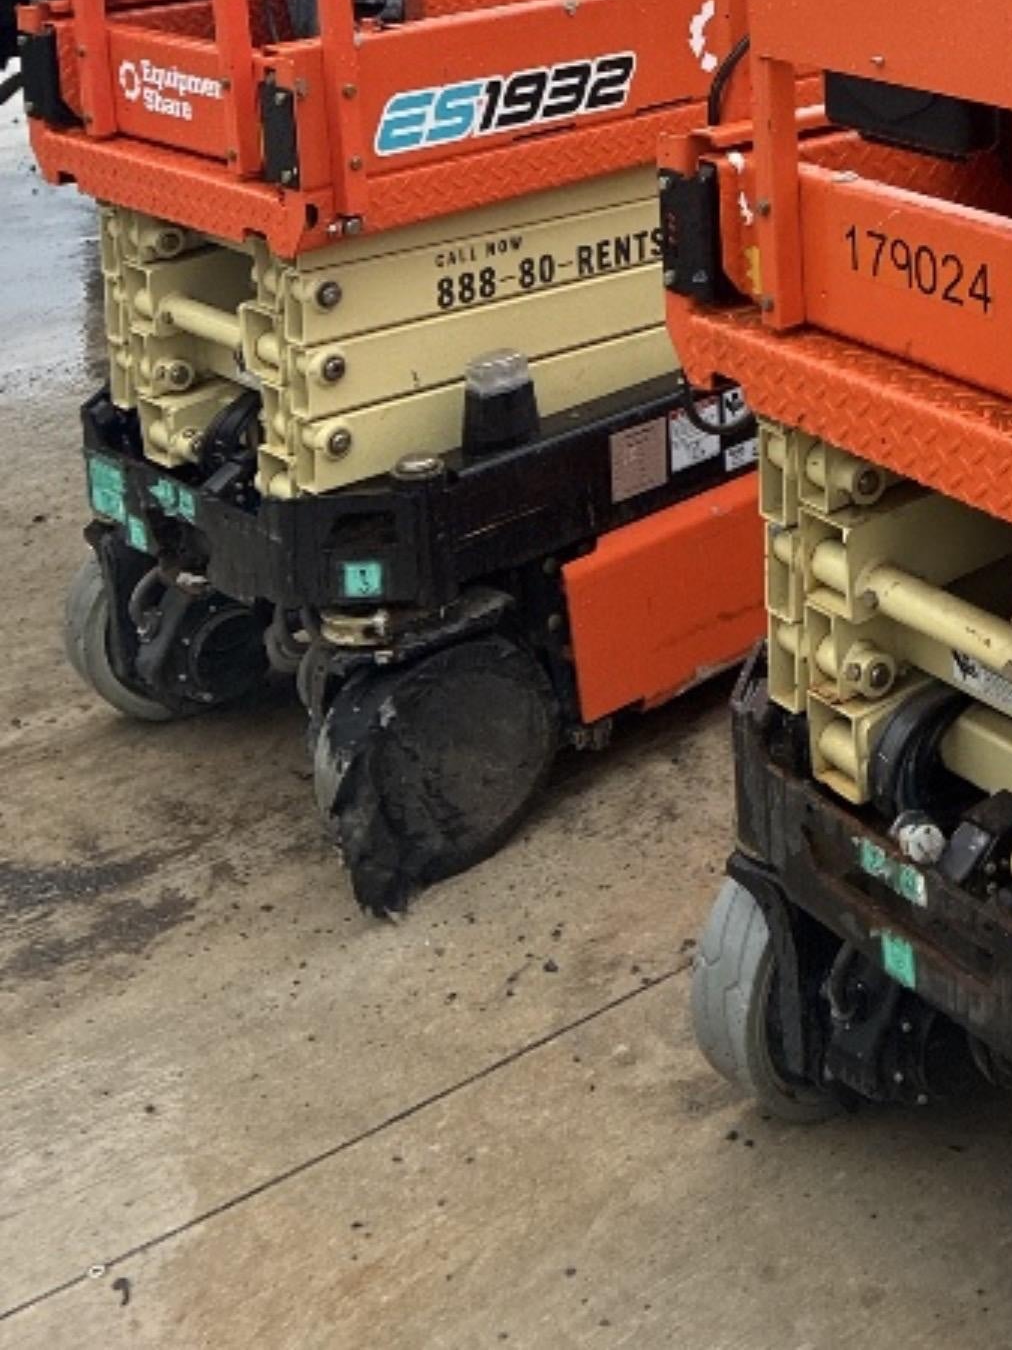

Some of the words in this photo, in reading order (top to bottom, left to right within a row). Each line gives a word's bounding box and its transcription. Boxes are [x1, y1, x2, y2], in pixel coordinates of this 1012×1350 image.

[143, 87, 193, 121] Share
[375, 52, 636, 155] ES1932
[435, 249, 476, 268] CALL
[485, 235, 523, 256] NOW
[436, 227, 664, 309] 888-80-RENTS
[845, 224, 992, 314] 179024
